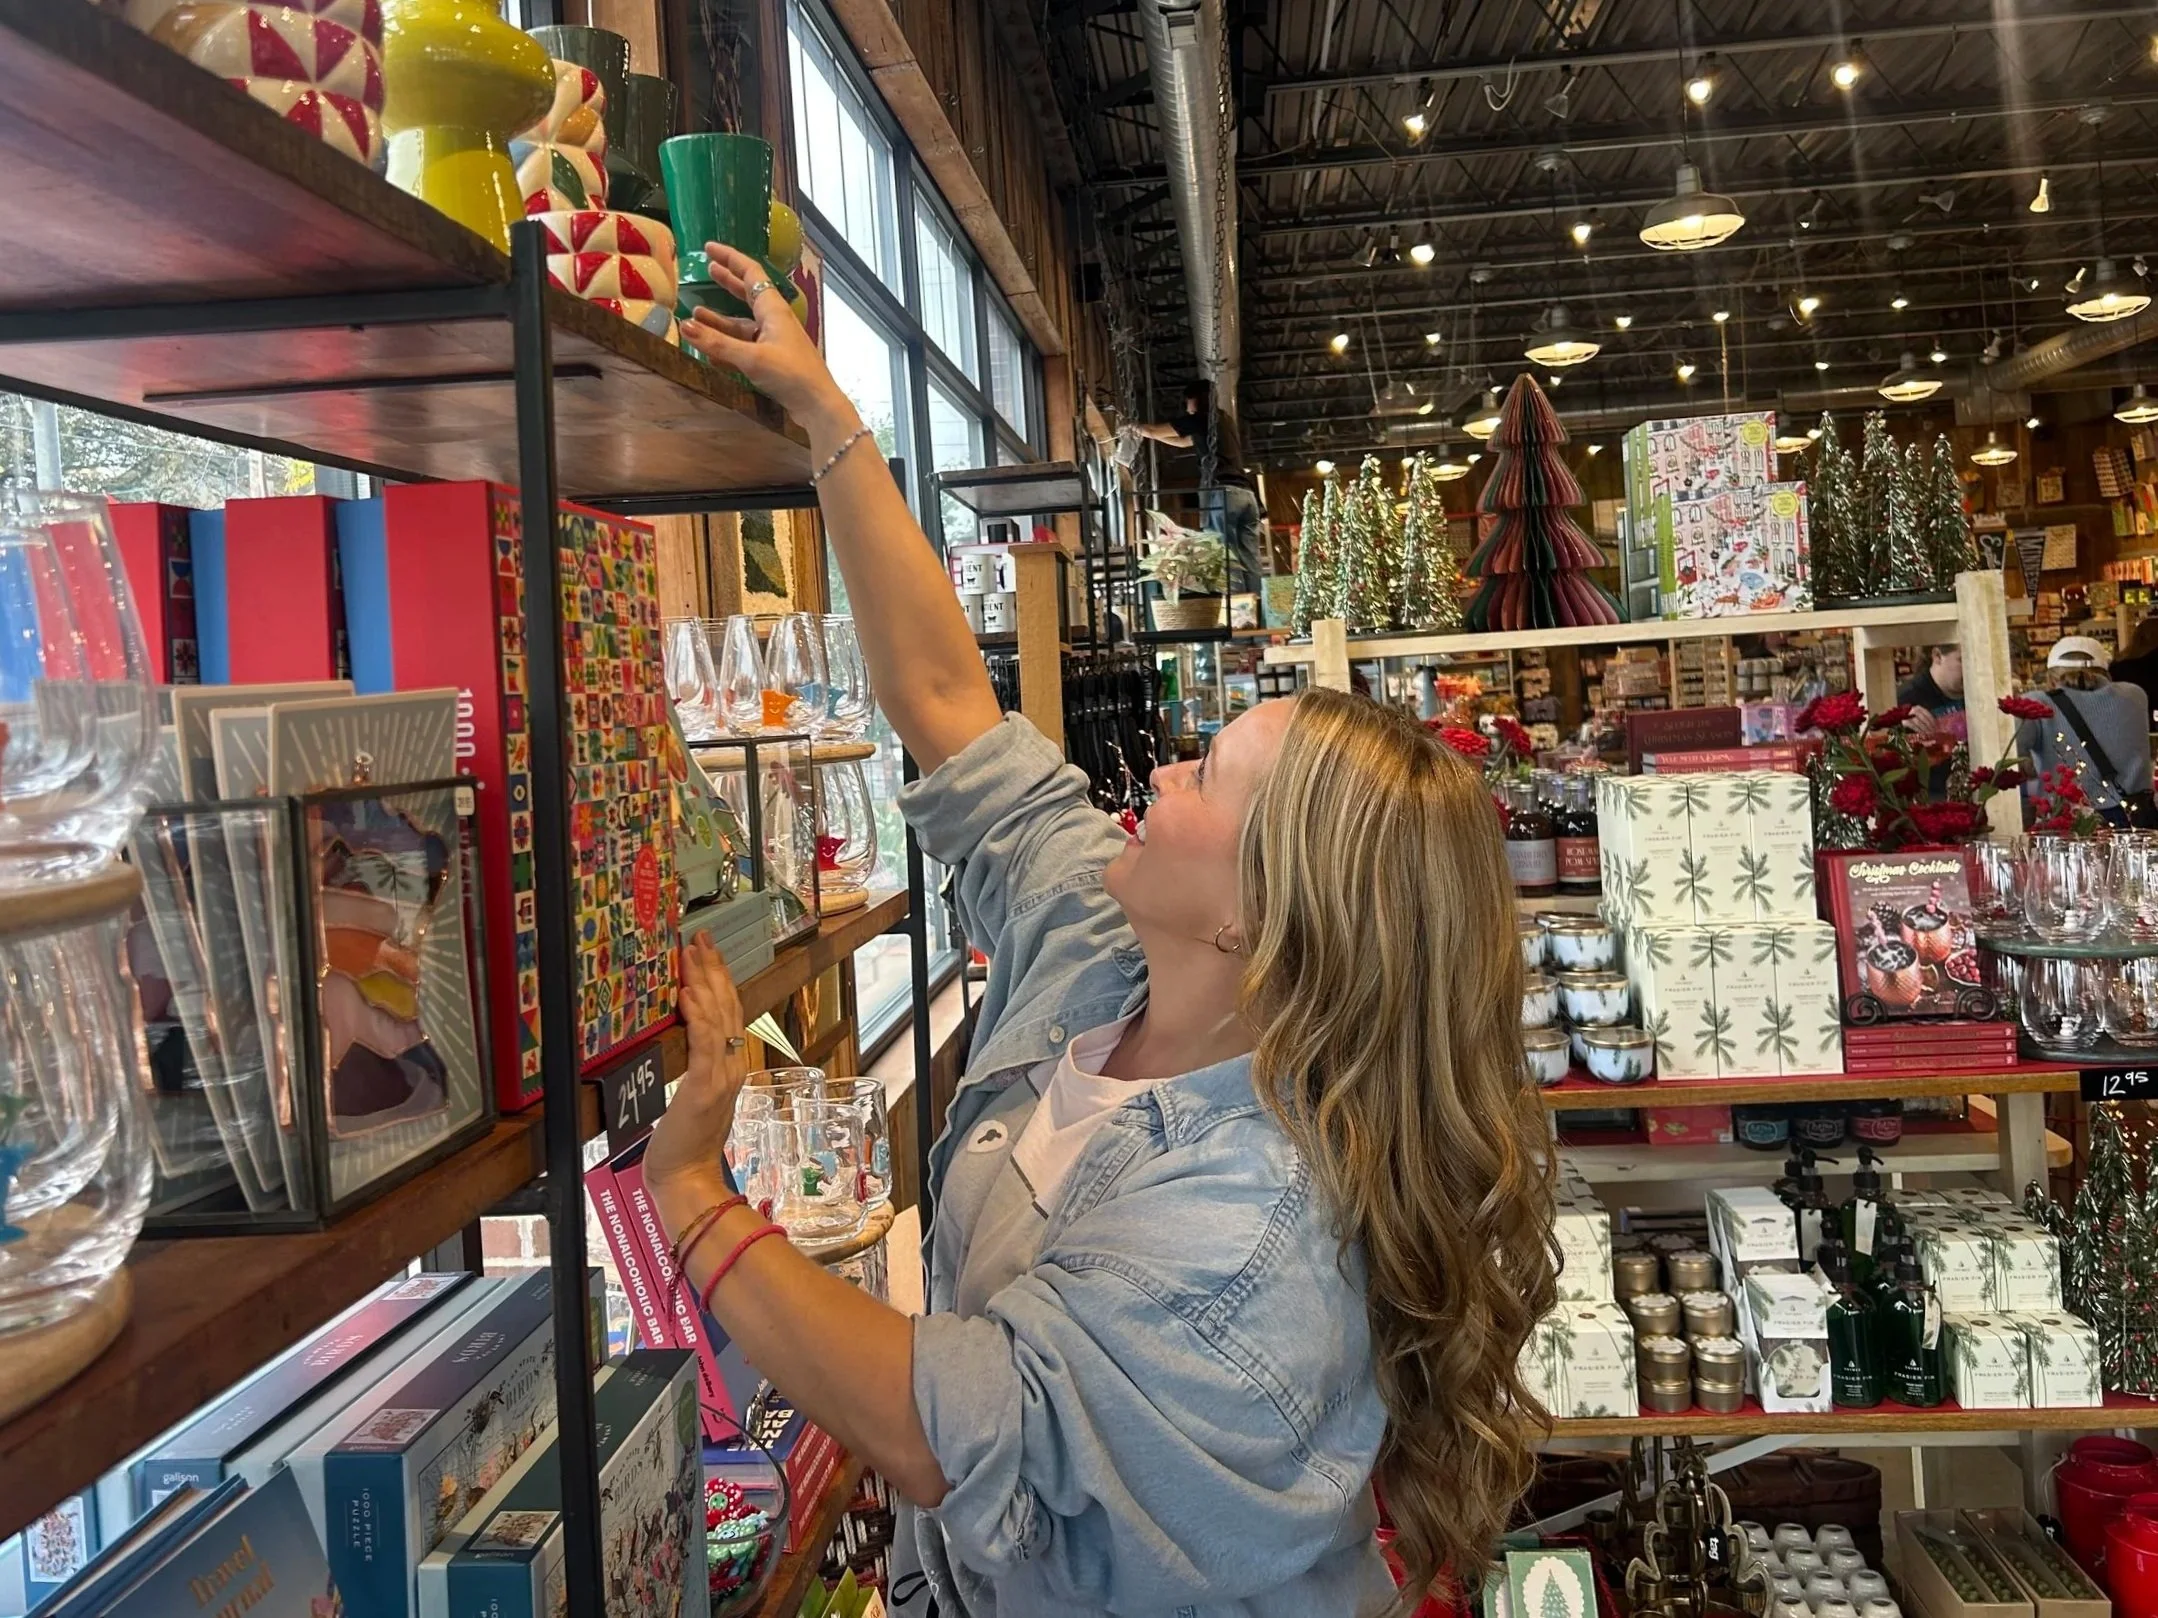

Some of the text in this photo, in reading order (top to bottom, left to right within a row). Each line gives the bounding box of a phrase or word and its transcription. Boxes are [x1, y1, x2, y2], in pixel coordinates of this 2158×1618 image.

[1849, 859, 1962, 885] Christmas Cocktails
[600, 1189, 664, 1345] THE NONALCOHOLIC BAR
[632, 1188, 697, 1344] THE NONALCOLIC BAR
[1894, 1371, 1922, 1380] FRASIER
[764, 1408, 795, 1419] BA
[163, 1472, 200, 1484] galison
[351, 1499, 361, 1549] PUZZLE
[362, 1487, 373, 1562] 1000 PIECE
[189, 1532, 254, 1609] Travel
[490, 1598, 499, 1618] 100
